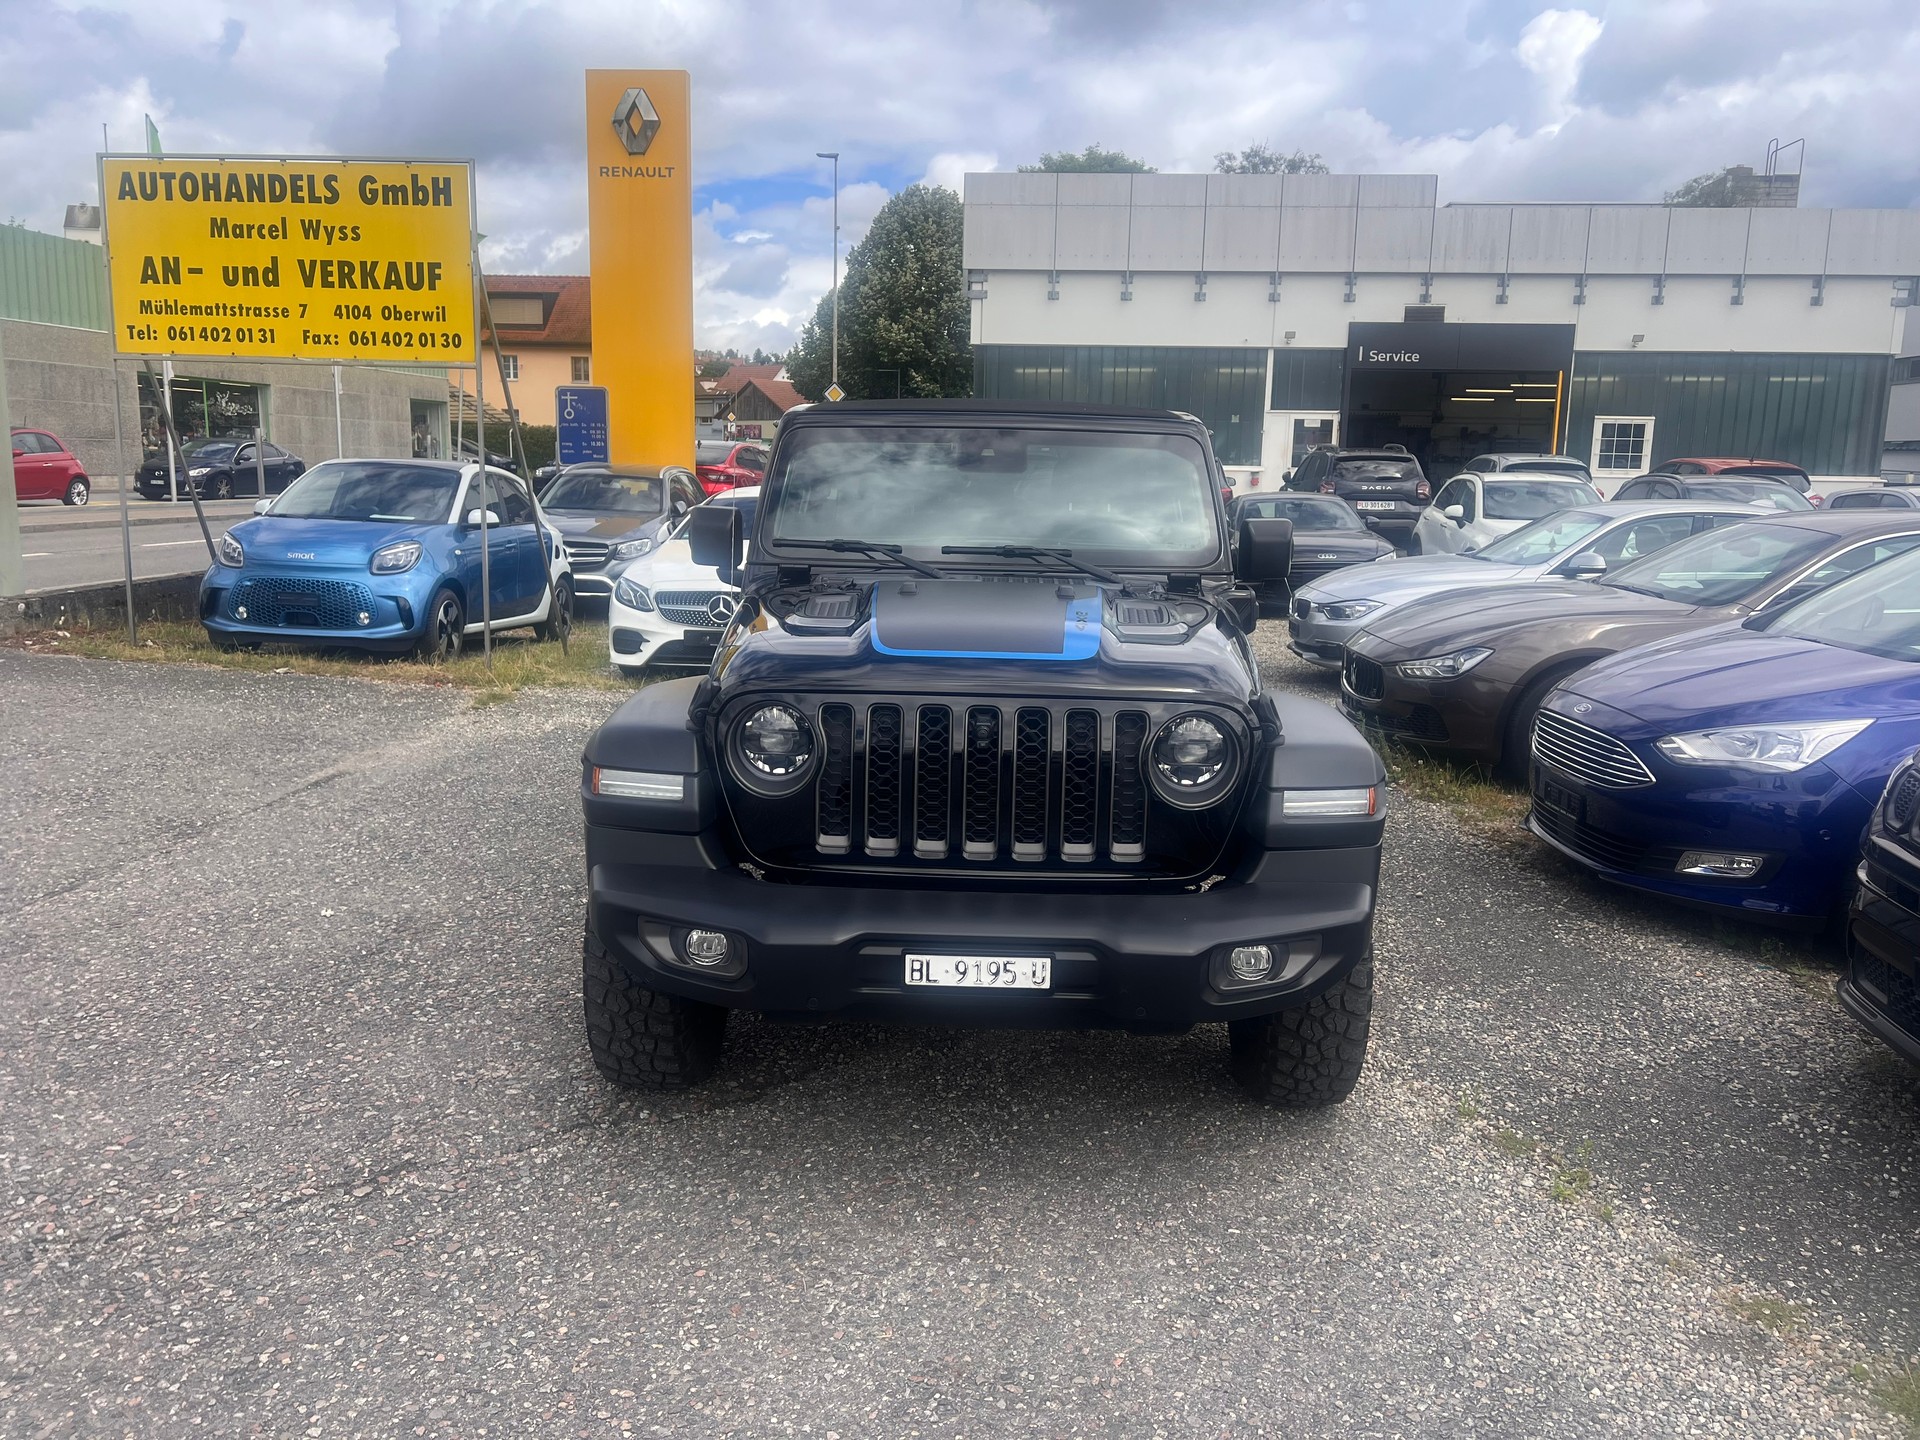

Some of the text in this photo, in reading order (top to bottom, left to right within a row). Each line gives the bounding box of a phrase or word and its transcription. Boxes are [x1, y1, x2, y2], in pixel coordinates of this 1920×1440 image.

[600, 166, 675, 178] RENAULT
[118, 171, 453, 207] AUTOHANDELS GmbH
[210, 217, 362, 246] Marcel Wyss
[222, 256, 280, 288] und
[296, 259, 442, 291] VERKAUF
[139, 299, 447, 322] Mühlemattstrasse 7 4104 Oberwil
[127, 324, 158, 341] Tel:
[302, 329, 340, 346] Fax:
[1369, 350, 1420, 362] Service
[287, 552, 316, 560] smart
[909, 957, 1047, 987] BL 9195 U
